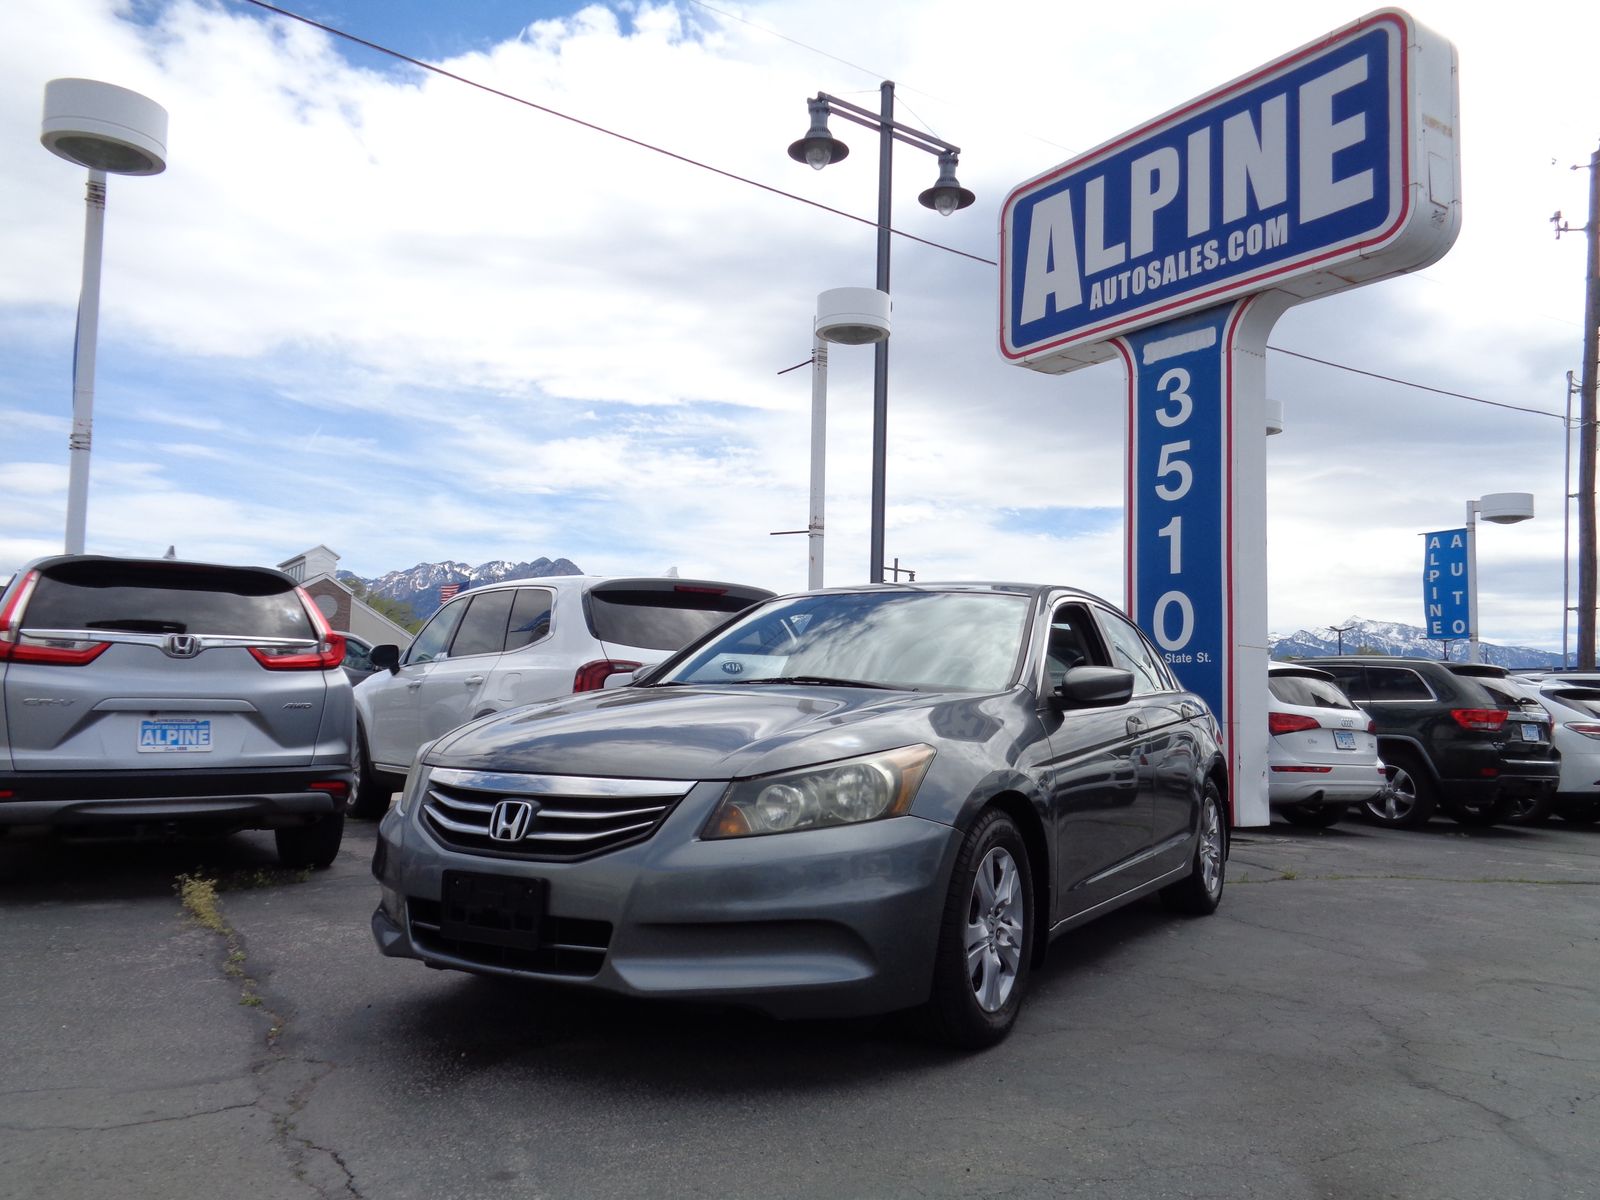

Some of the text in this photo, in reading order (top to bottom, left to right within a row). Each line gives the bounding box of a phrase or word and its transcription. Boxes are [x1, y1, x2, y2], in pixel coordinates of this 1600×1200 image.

[1020, 53, 1374, 326] ALPINE
[1089, 212, 1289, 311] AUTOSALES.COM
[1428, 536, 1442, 635] ALPINE
[1450, 534, 1466, 634] AUTO
[725, 663, 741, 671] KIA
[1165, 652, 1212, 663] State St.
[142, 730, 209, 745] ALPINE
